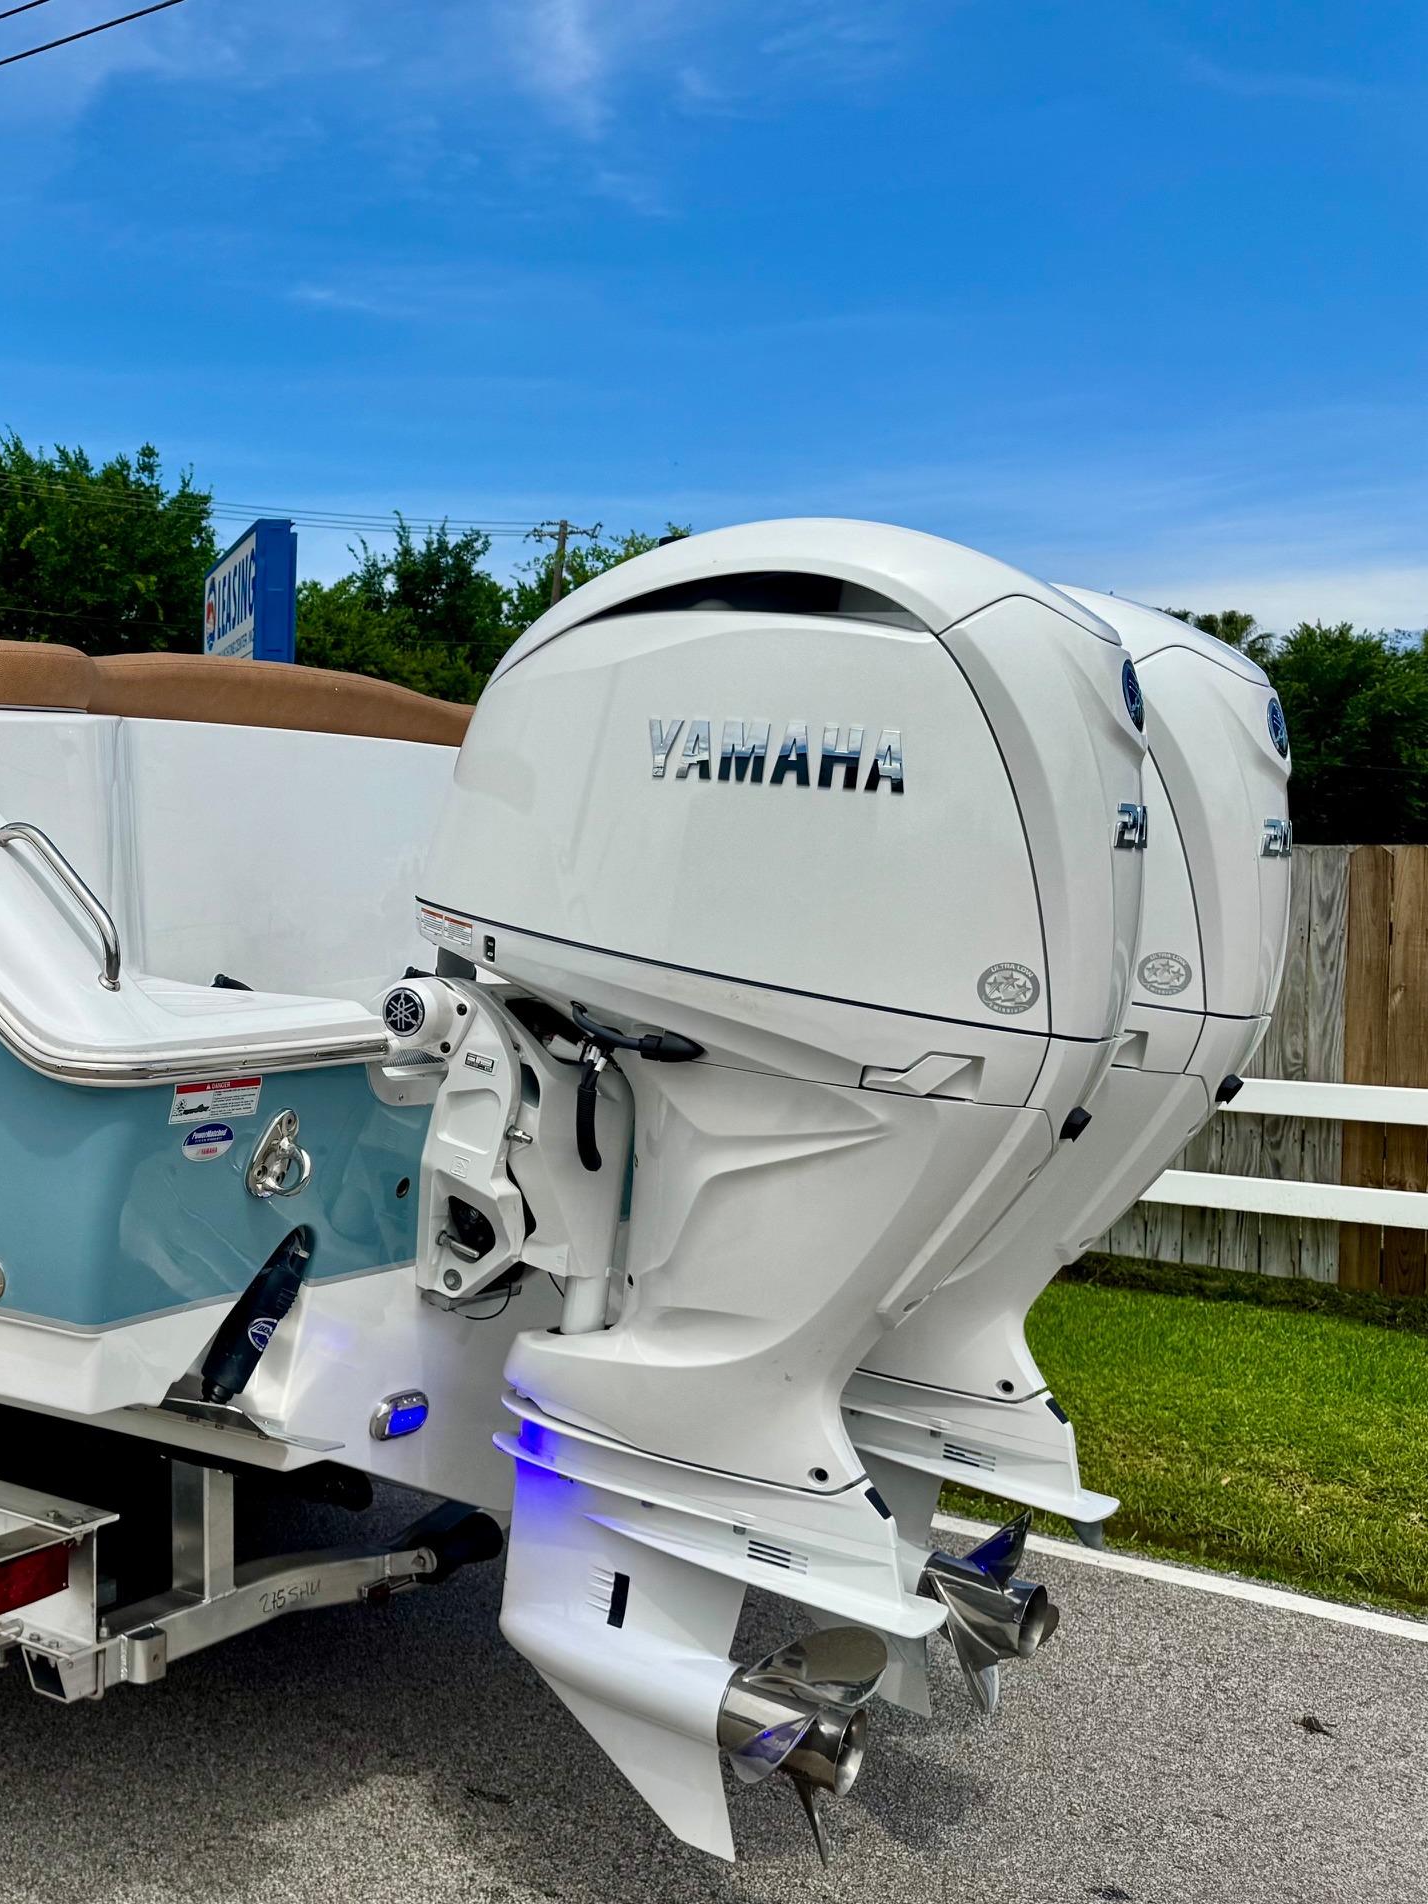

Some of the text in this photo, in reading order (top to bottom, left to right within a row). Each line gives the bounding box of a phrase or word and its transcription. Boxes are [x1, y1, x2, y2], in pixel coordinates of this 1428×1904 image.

[218, 548, 255, 640] LEASING
[649, 719, 904, 795] YAMAHA
[991, 963, 1034, 977] ULTRA LOW
[212, 1081, 231, 1089] DANGER
